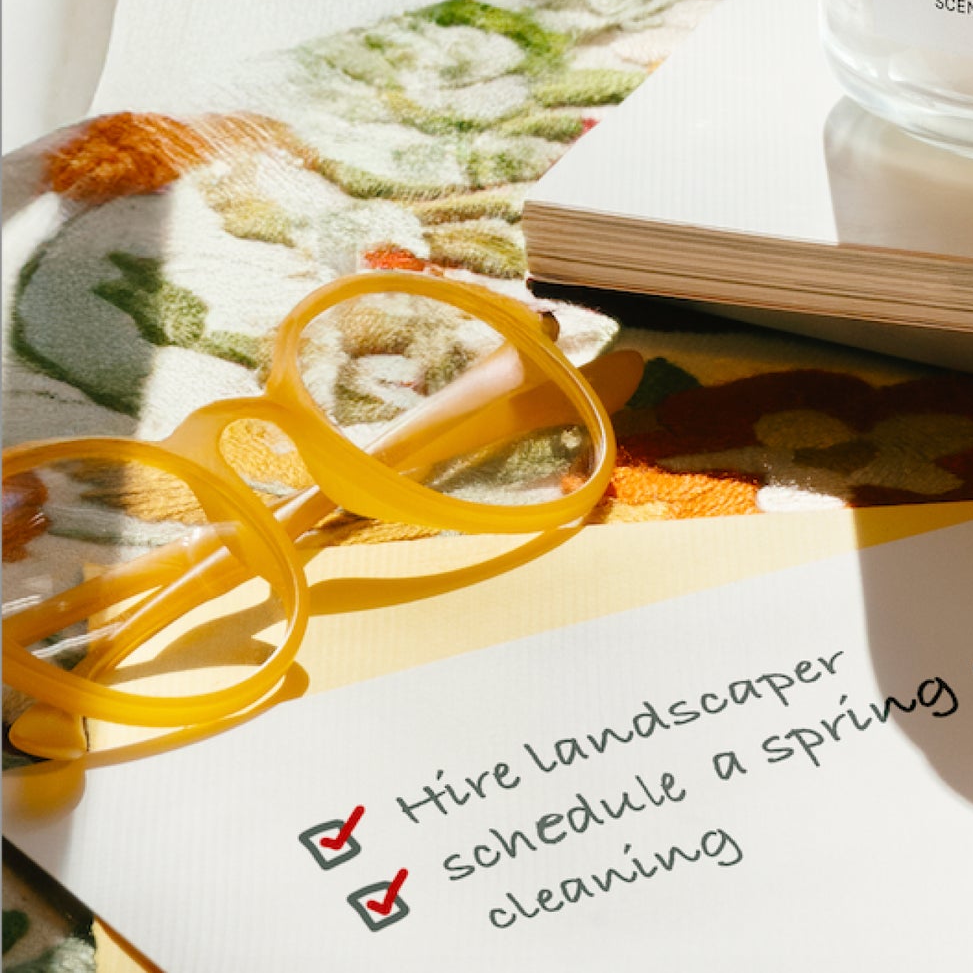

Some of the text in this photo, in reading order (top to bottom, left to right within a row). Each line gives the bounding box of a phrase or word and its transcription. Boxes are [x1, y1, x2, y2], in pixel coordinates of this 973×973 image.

[396, 650, 845, 824] Hire landscaper
[442, 771, 686, 882] schedule
[712, 750, 748, 780] a
[761, 676, 959, 767] spring
[489, 827, 744, 929] cleaning
